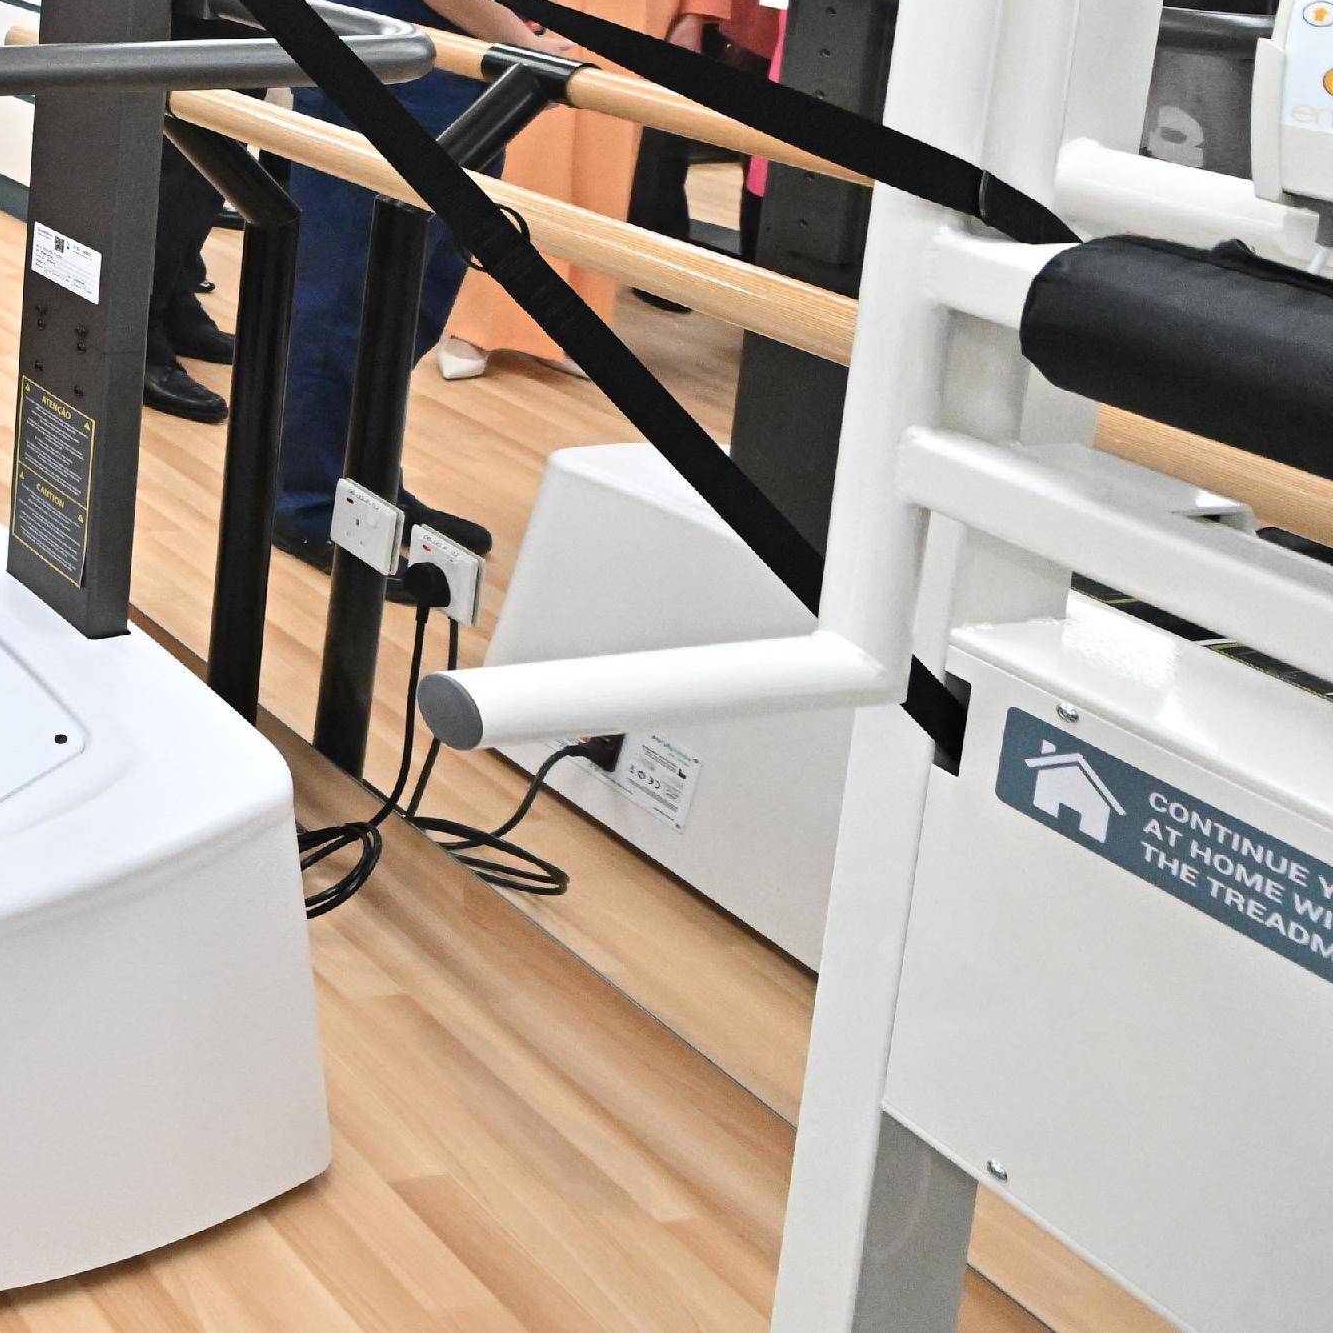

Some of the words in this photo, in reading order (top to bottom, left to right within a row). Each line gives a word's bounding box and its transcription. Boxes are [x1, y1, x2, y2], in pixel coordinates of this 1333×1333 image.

[36, 483, 65, 509] CAUTION
[1143, 819, 1183, 848] AT
[1190, 839, 1285, 905] HOME
[1149, 792, 1310, 888] CONTINUE
[1141, 841, 1200, 888] THE
[1207, 876, 1333, 964] TREADM
